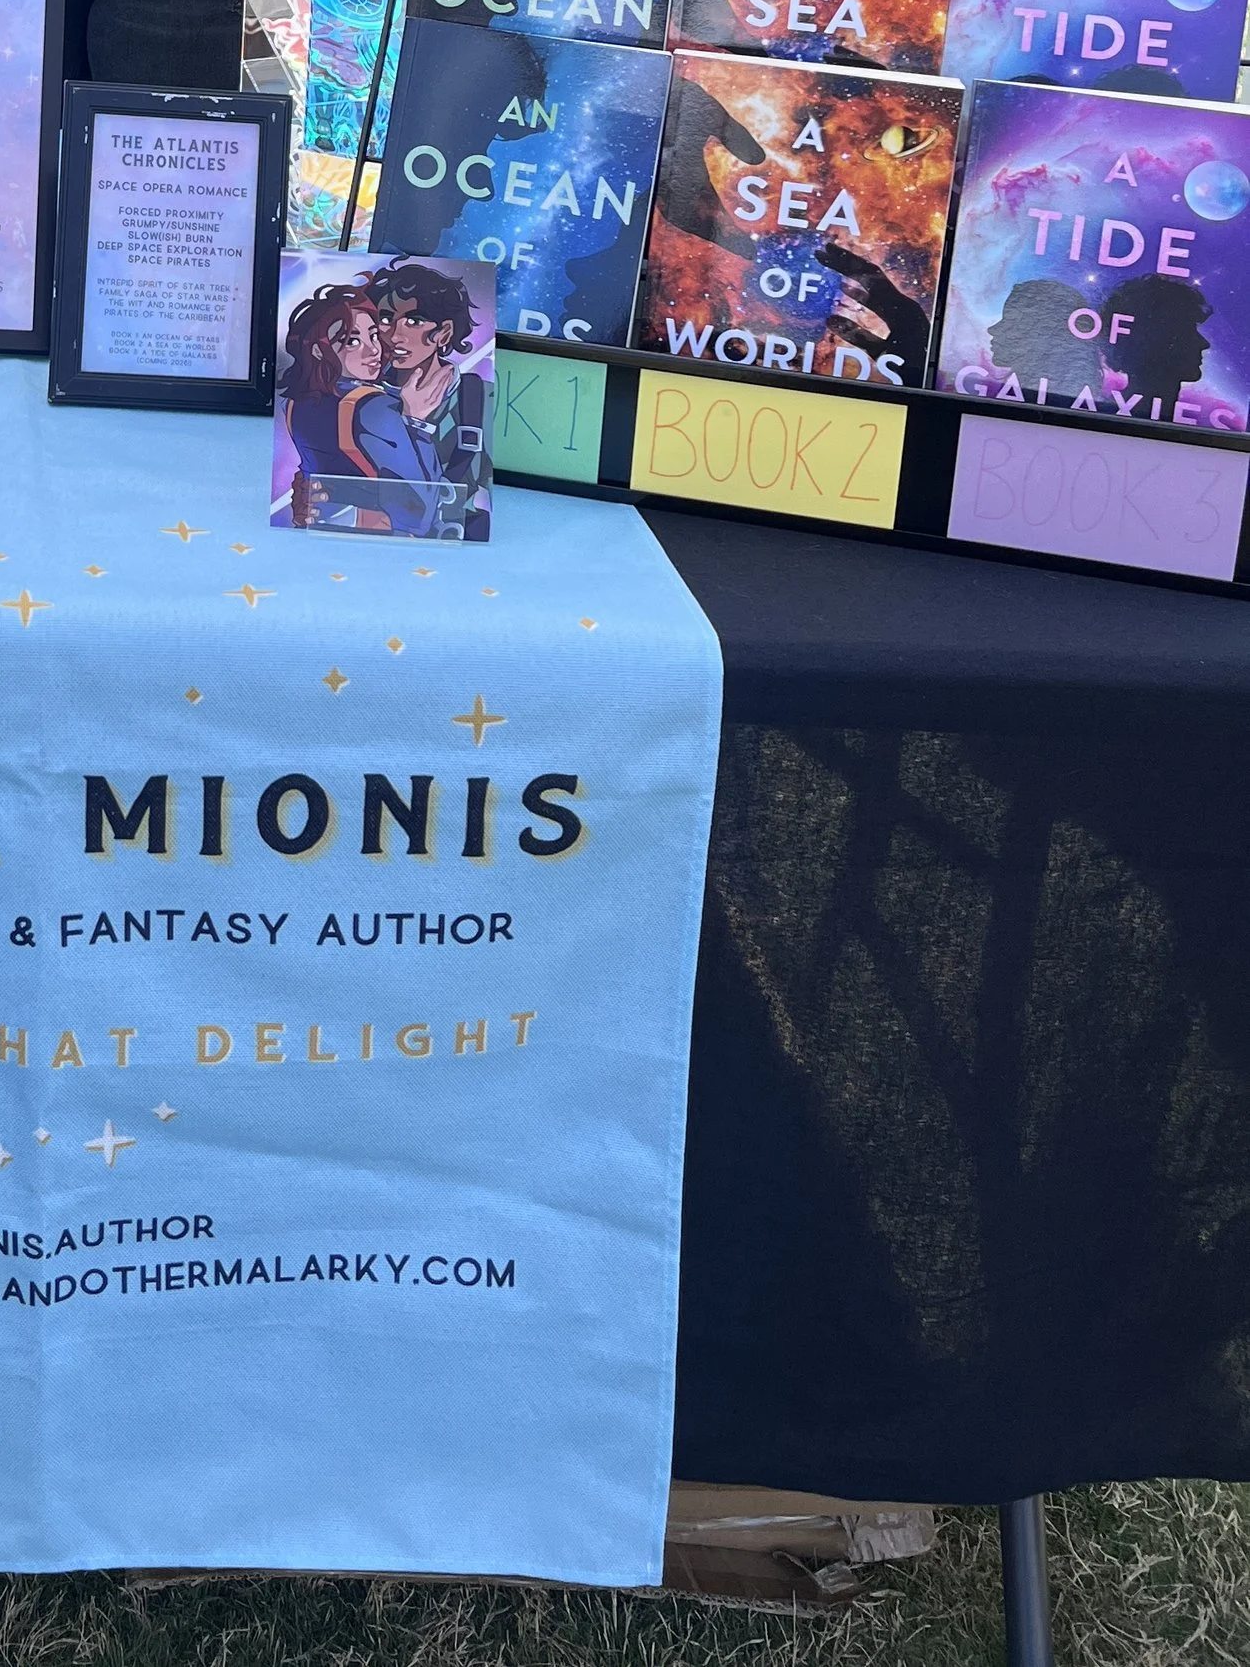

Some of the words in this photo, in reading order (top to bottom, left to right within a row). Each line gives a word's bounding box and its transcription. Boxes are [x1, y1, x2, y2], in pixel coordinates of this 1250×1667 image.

[1013, 7, 1173, 67] TIDE
[498, 96, 558, 131] AN
[112, 135, 143, 149] THE
[154, 137, 239, 154] ATLANTIS
[792, 118, 825, 152] A
[122, 154, 226, 171] CHRONICLES
[1104, 152, 1138, 187] A
[98, 180, 137, 191] SPACE
[143, 183, 182, 194] OPERA
[188, 186, 248, 197] ROMANCE
[403, 145, 637, 225] OCEAN
[119, 206, 161, 217] FORCED
[166, 209, 224, 220] PROXIMITY
[734, 176, 860, 236] SEA
[122, 219, 220, 232] GRUMPY/SUNSHINE
[128, 231, 181, 242] SLOW(ISH)
[186, 235, 213, 243] BURN
[1028, 208, 1195, 277] TIDE
[98, 241, 123, 251] DEEP
[128, 243, 162, 253] SPACE
[167, 245, 242, 257] EXPLORATION
[128, 255, 162, 265] SPACE
[167, 257, 210, 267] PIRATES
[477, 236, 533, 270] OF
[760, 267, 822, 301] OF
[1068, 309, 1134, 344] OF
[563, 376, 578, 451] 1
[649, 389, 832, 496] BOOK
[840, 424, 880, 501] 2
[973, 437, 1160, 541] BOOK
[1183, 469, 1222, 543] 3
[83, 772, 585, 861] MIONIS
[10, 916, 36, 947] &
[60, 910, 289, 947] FANTASY
[317, 913, 514, 946] AUTHOR
[196, 1011, 536, 1065] DELIGHT
